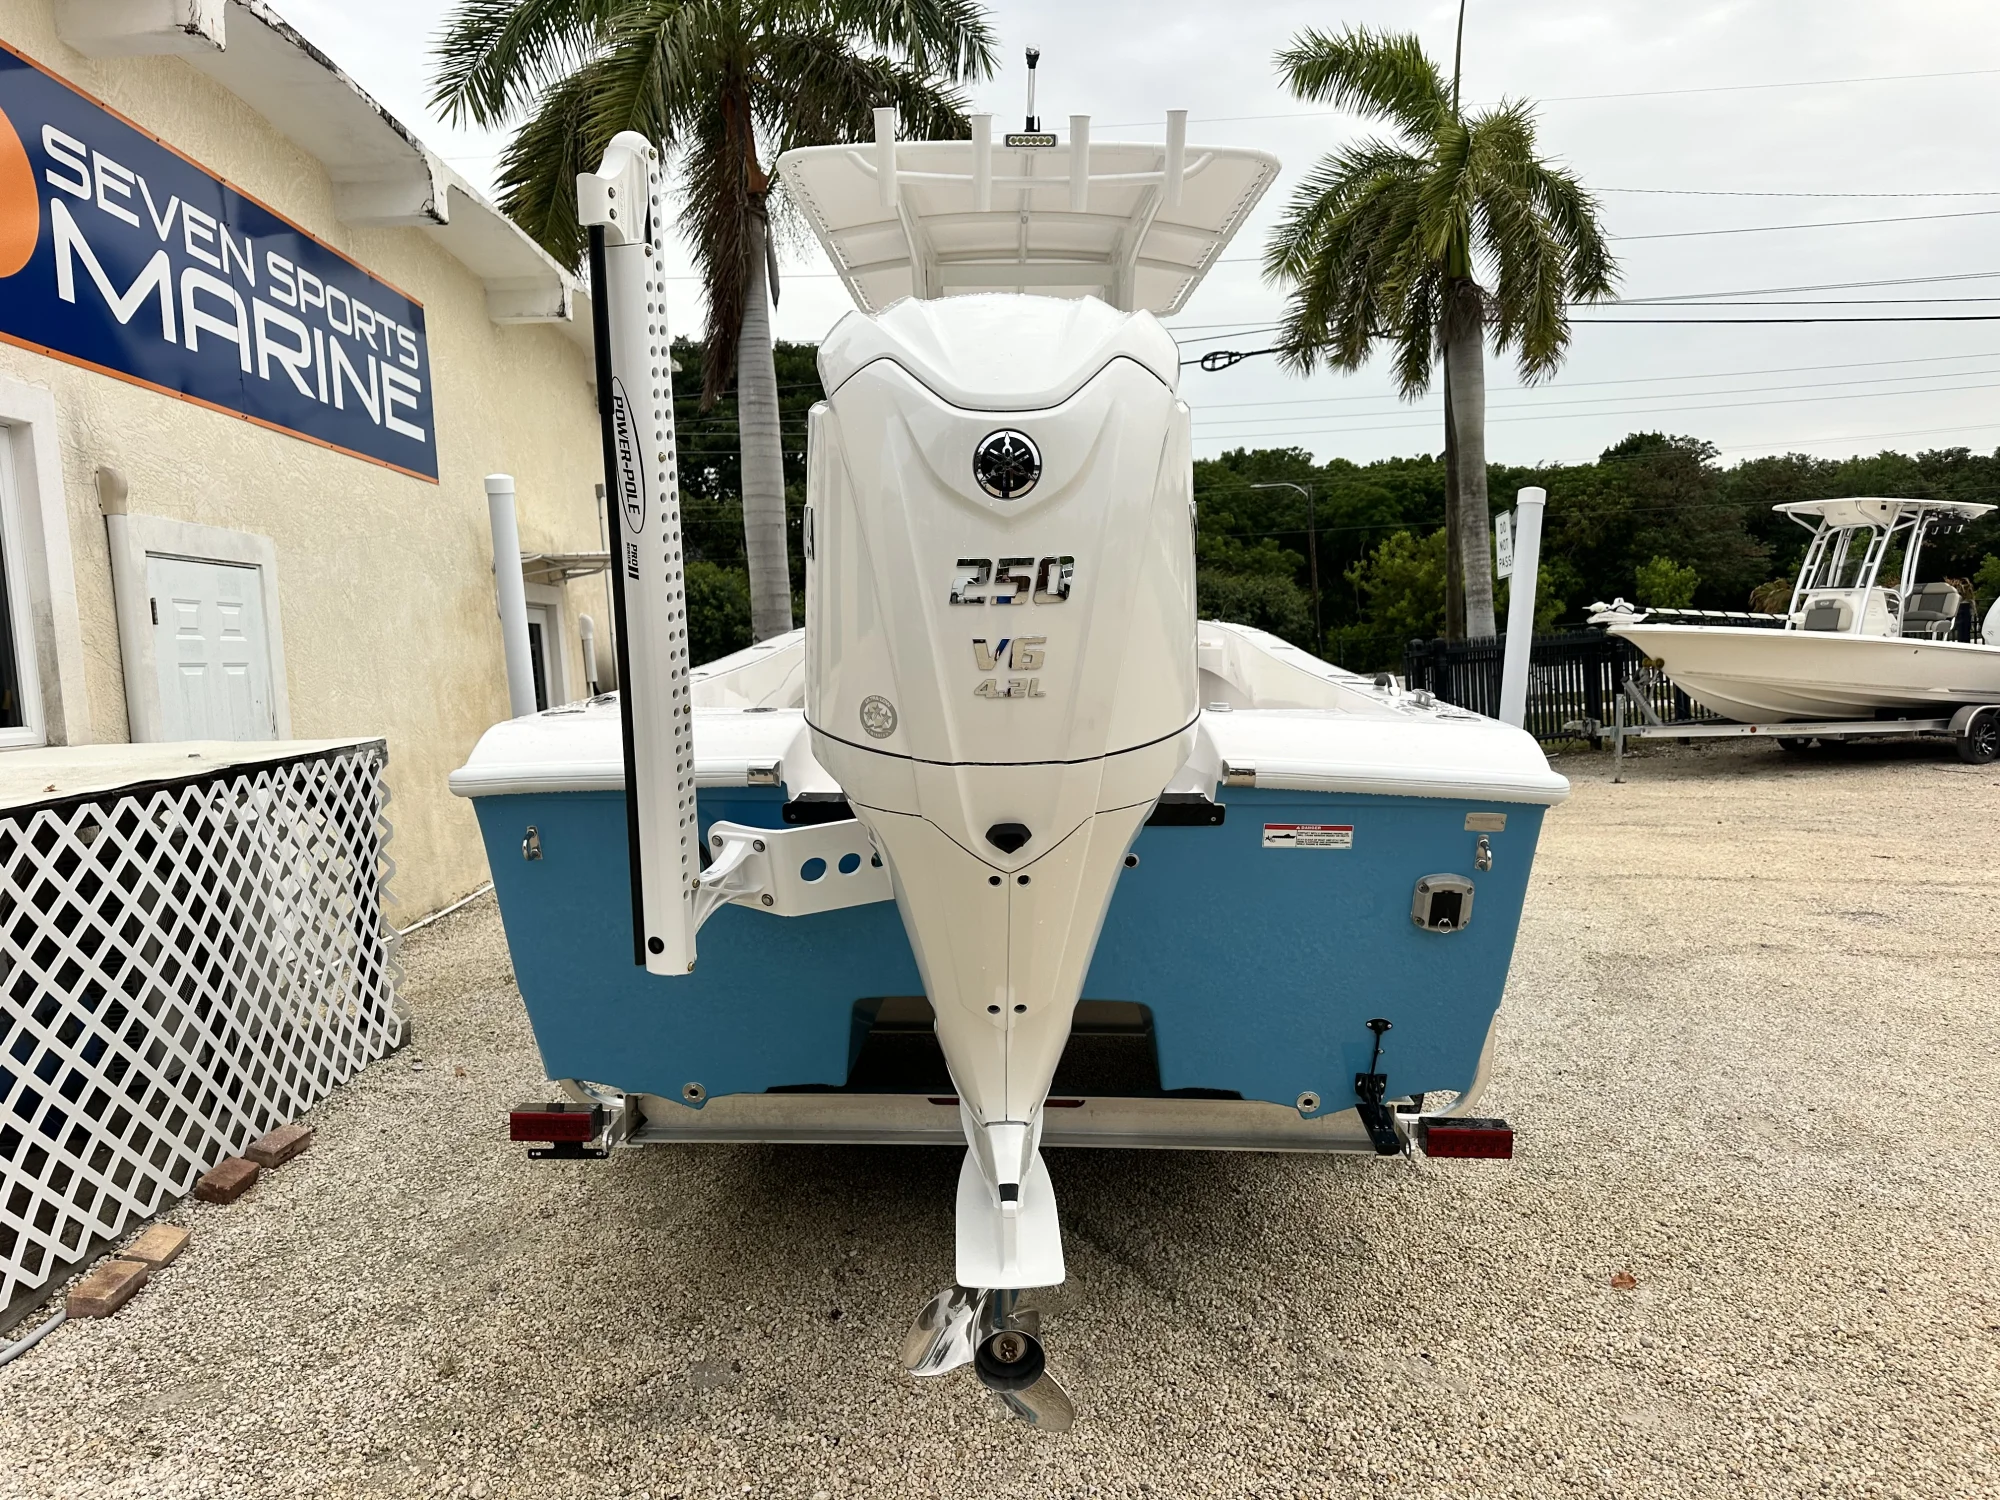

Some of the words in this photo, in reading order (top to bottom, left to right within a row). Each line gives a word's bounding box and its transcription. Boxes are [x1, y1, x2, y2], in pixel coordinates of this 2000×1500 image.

[42, 124, 256, 288] SEVEN
[266, 250, 419, 370] SPORTS
[50, 197, 425, 443] MARINE
[613, 396, 640, 515] POWER-POLE
[1499, 538, 1509, 552] NOT
[1500, 521, 1506, 535] DO
[1499, 555, 1512, 568] PASS
[949, 556, 1075, 606] 250
[972, 636, 1047, 671] V6
[973, 678, 1046, 699] 4.2L
